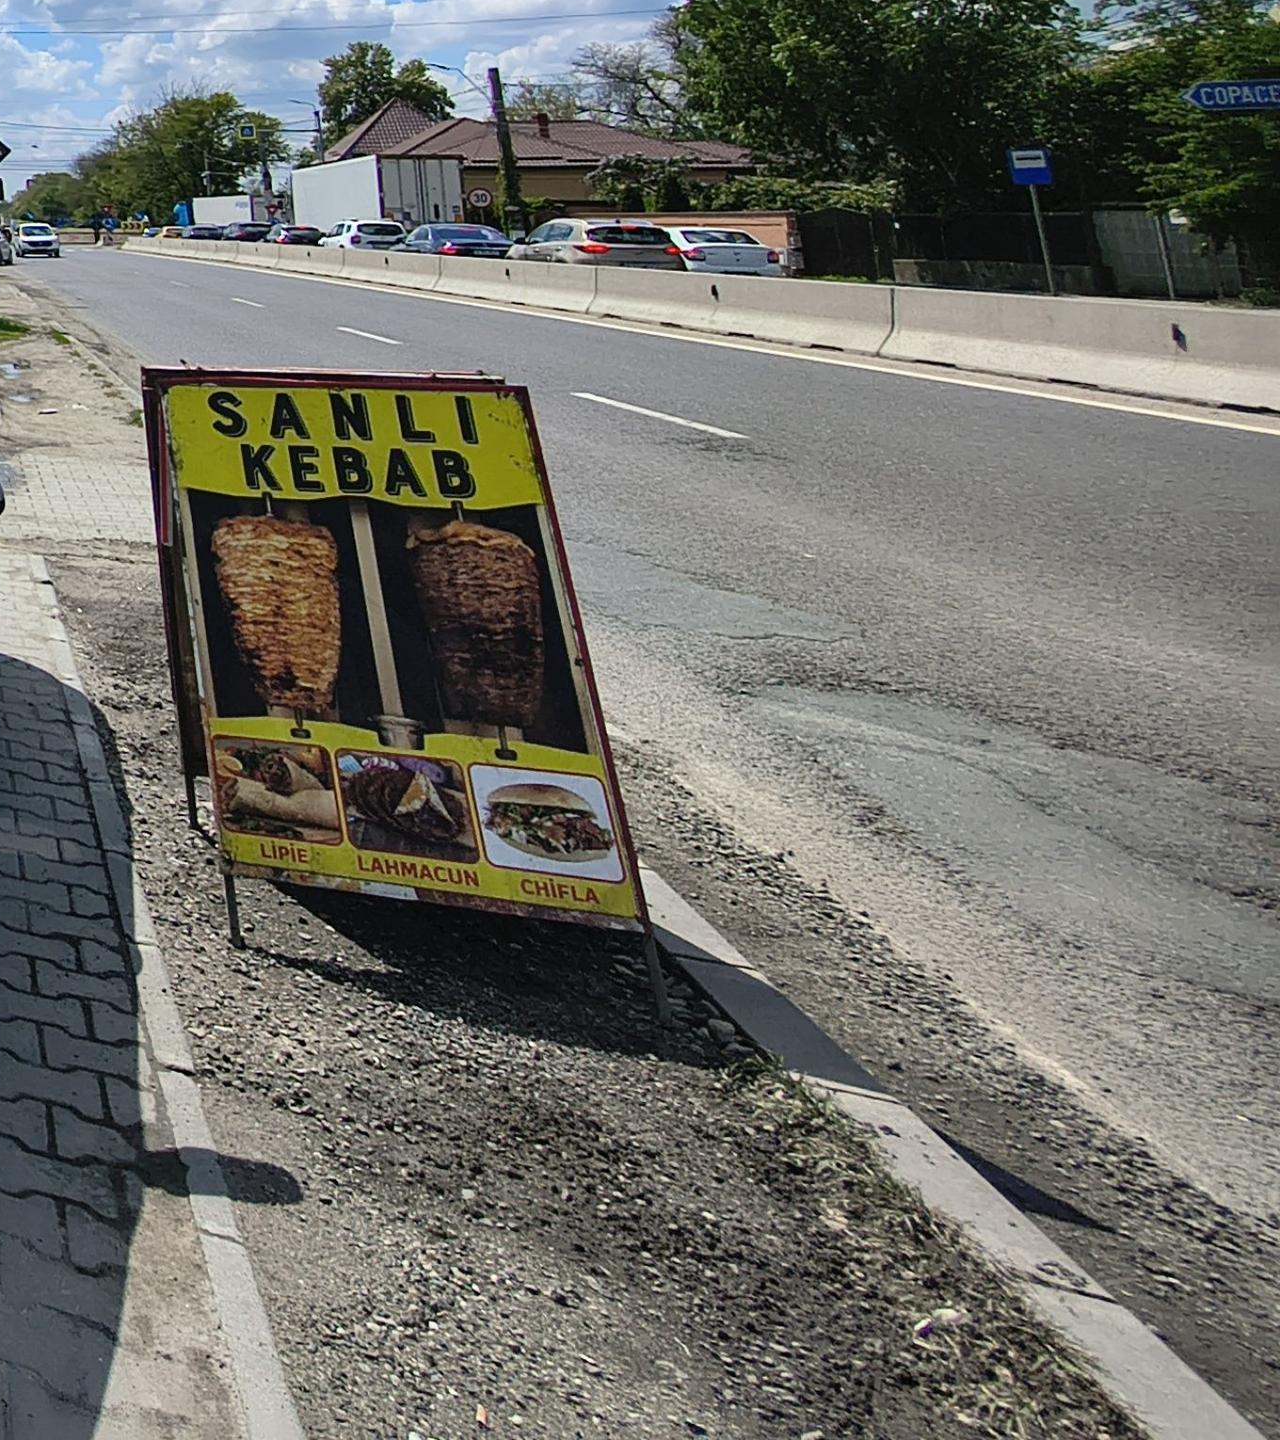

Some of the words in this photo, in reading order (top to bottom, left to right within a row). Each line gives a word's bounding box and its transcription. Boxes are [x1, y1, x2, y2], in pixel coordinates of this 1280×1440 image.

[473, 192, 488, 204] 30
[207, 391, 480, 444] SANLI
[240, 443, 477, 499] KEBAB
[357, 855, 480, 887] LAHMACUN
